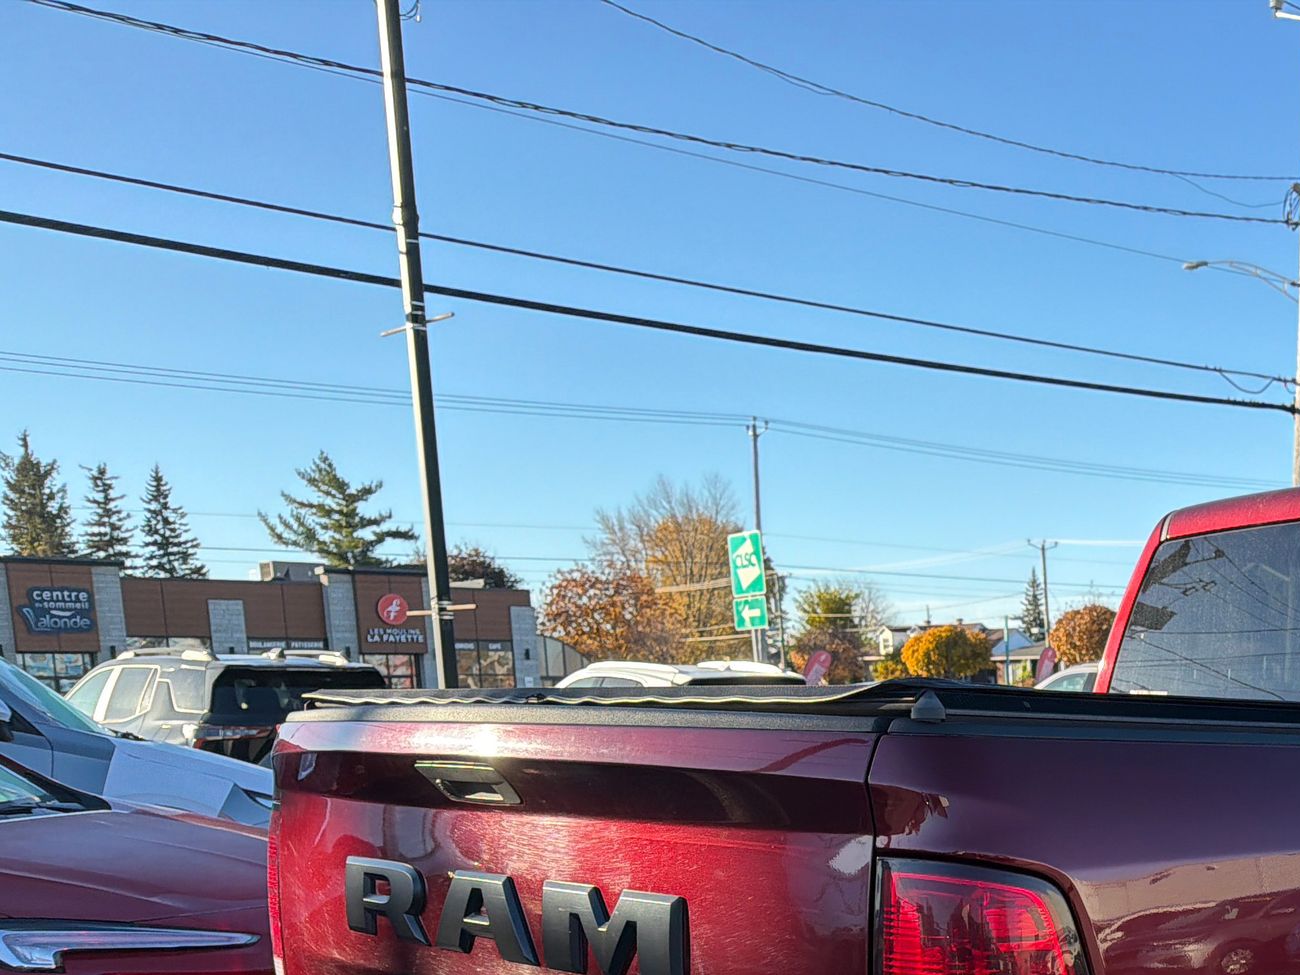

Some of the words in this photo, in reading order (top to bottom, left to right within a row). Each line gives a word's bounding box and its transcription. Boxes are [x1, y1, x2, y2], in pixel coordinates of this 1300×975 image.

[734, 552, 757, 569] CLSC
[32, 590, 89, 601] centre
[43, 602, 89, 610] sommeil
[367, 634, 380, 643] LA
[383, 634, 424, 643] FAYETTE
